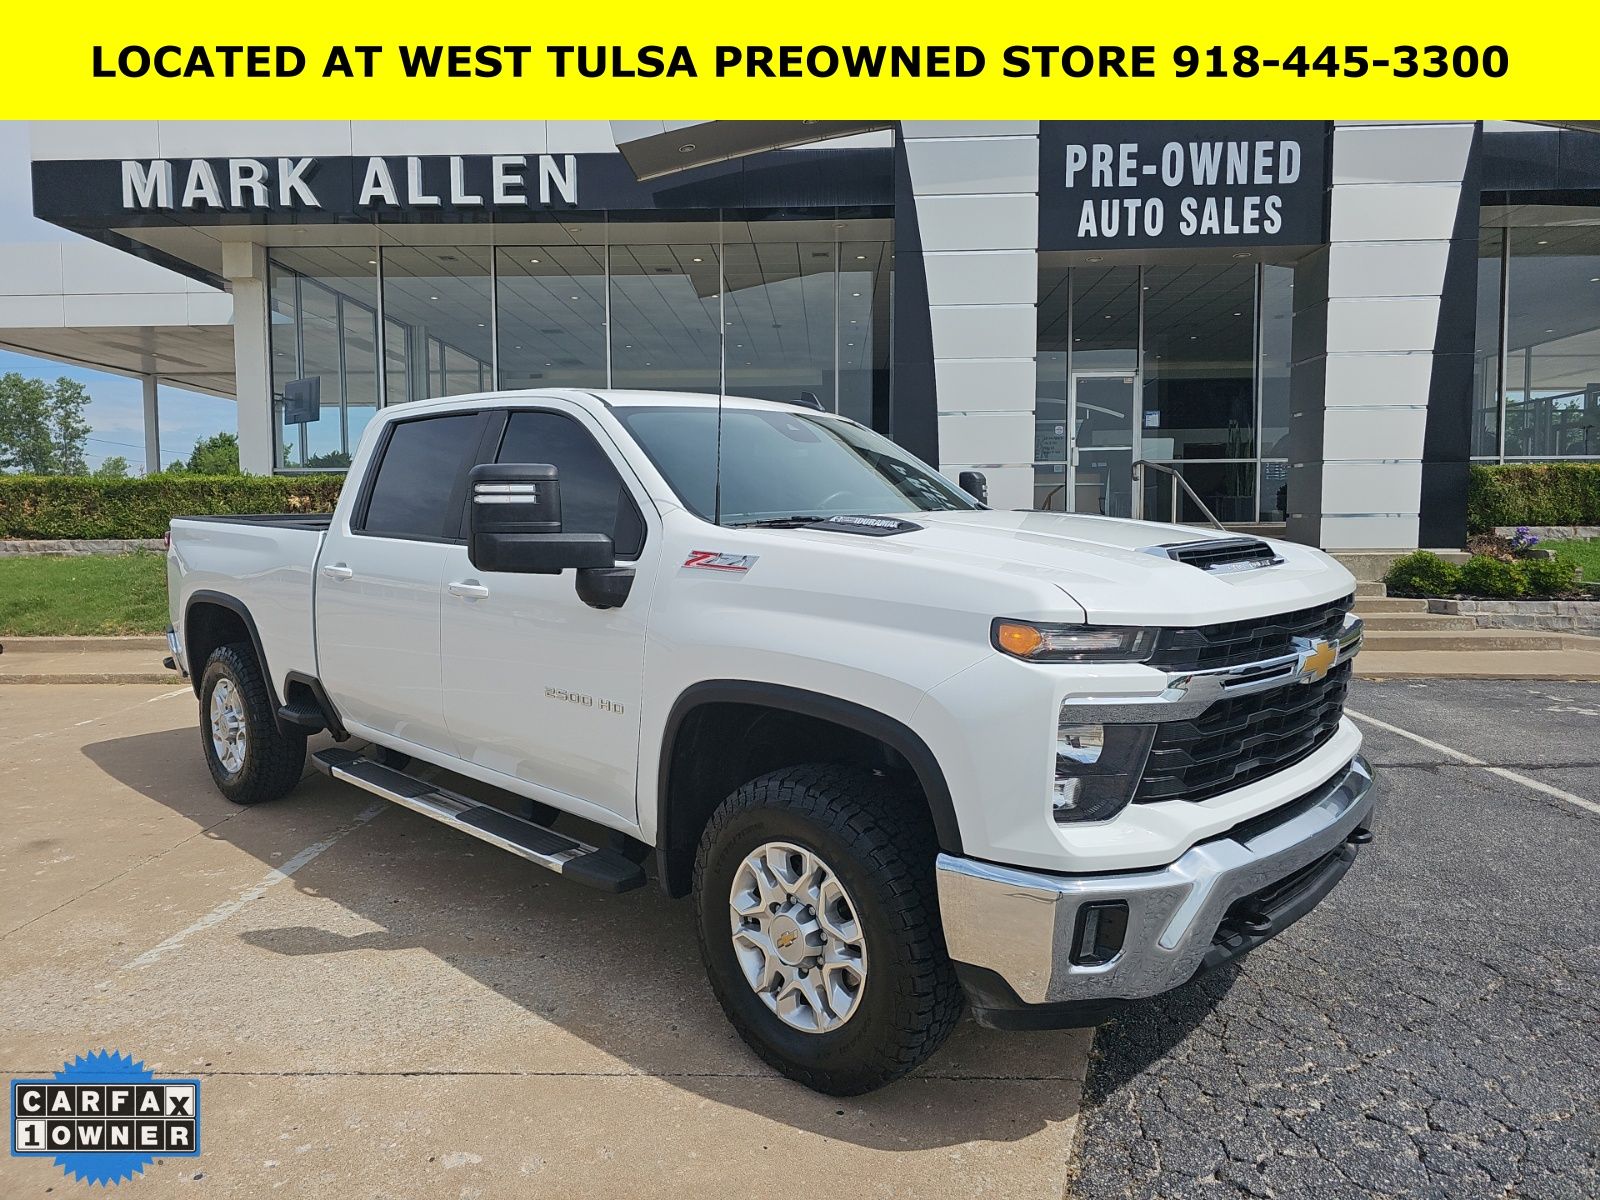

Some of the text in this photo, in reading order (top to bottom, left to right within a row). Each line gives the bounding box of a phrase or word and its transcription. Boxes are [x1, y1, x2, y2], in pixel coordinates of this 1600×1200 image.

[121, 155, 577, 210] MARK ALLEN
[1065, 140, 1301, 188] PRE-OWNED
[1078, 195, 1282, 238] AUTO SALES
[683, 550, 752, 572] Z71
[545, 687, 624, 714] 2500 HD
